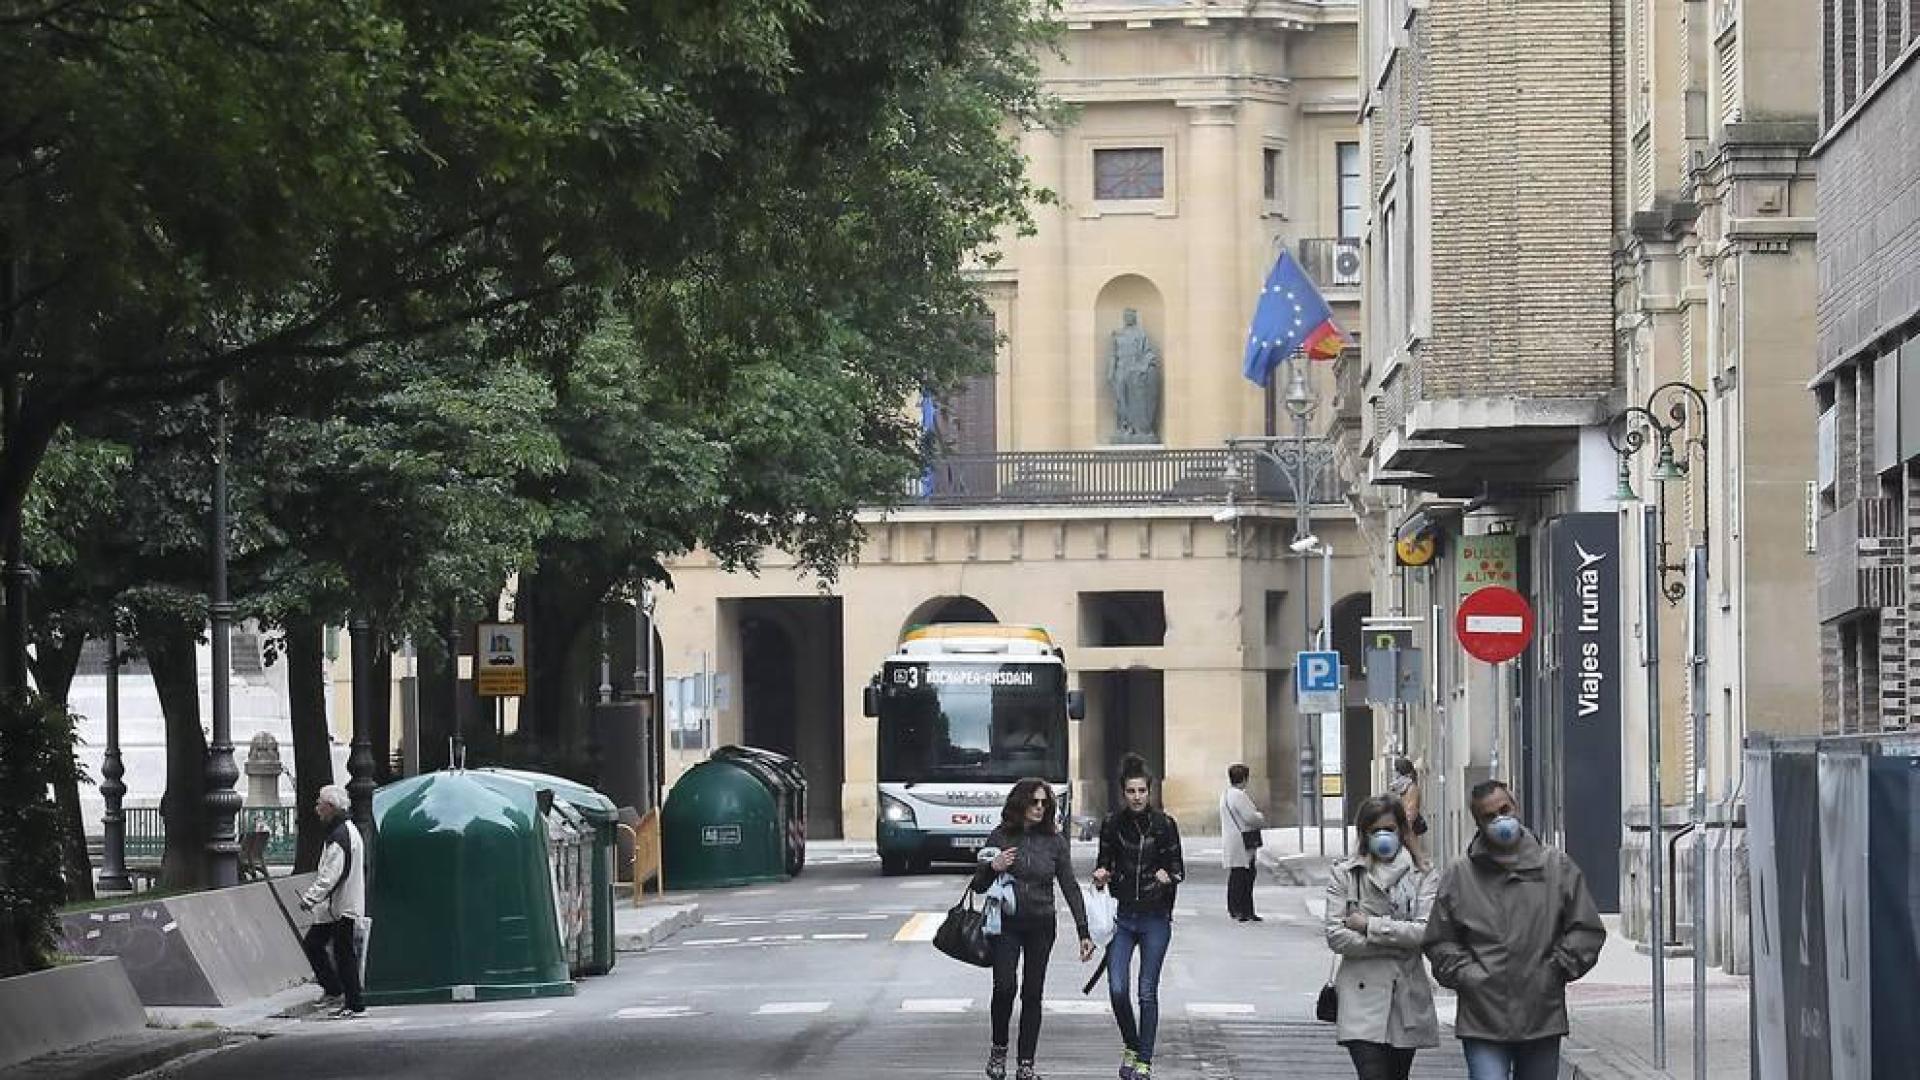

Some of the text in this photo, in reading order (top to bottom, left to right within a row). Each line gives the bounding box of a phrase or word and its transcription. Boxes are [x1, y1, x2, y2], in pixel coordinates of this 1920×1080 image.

[1576, 569, 1603, 717] Viajes Iruña
[908, 666, 918, 688] 3
[1306, 658, 1331, 687] P
